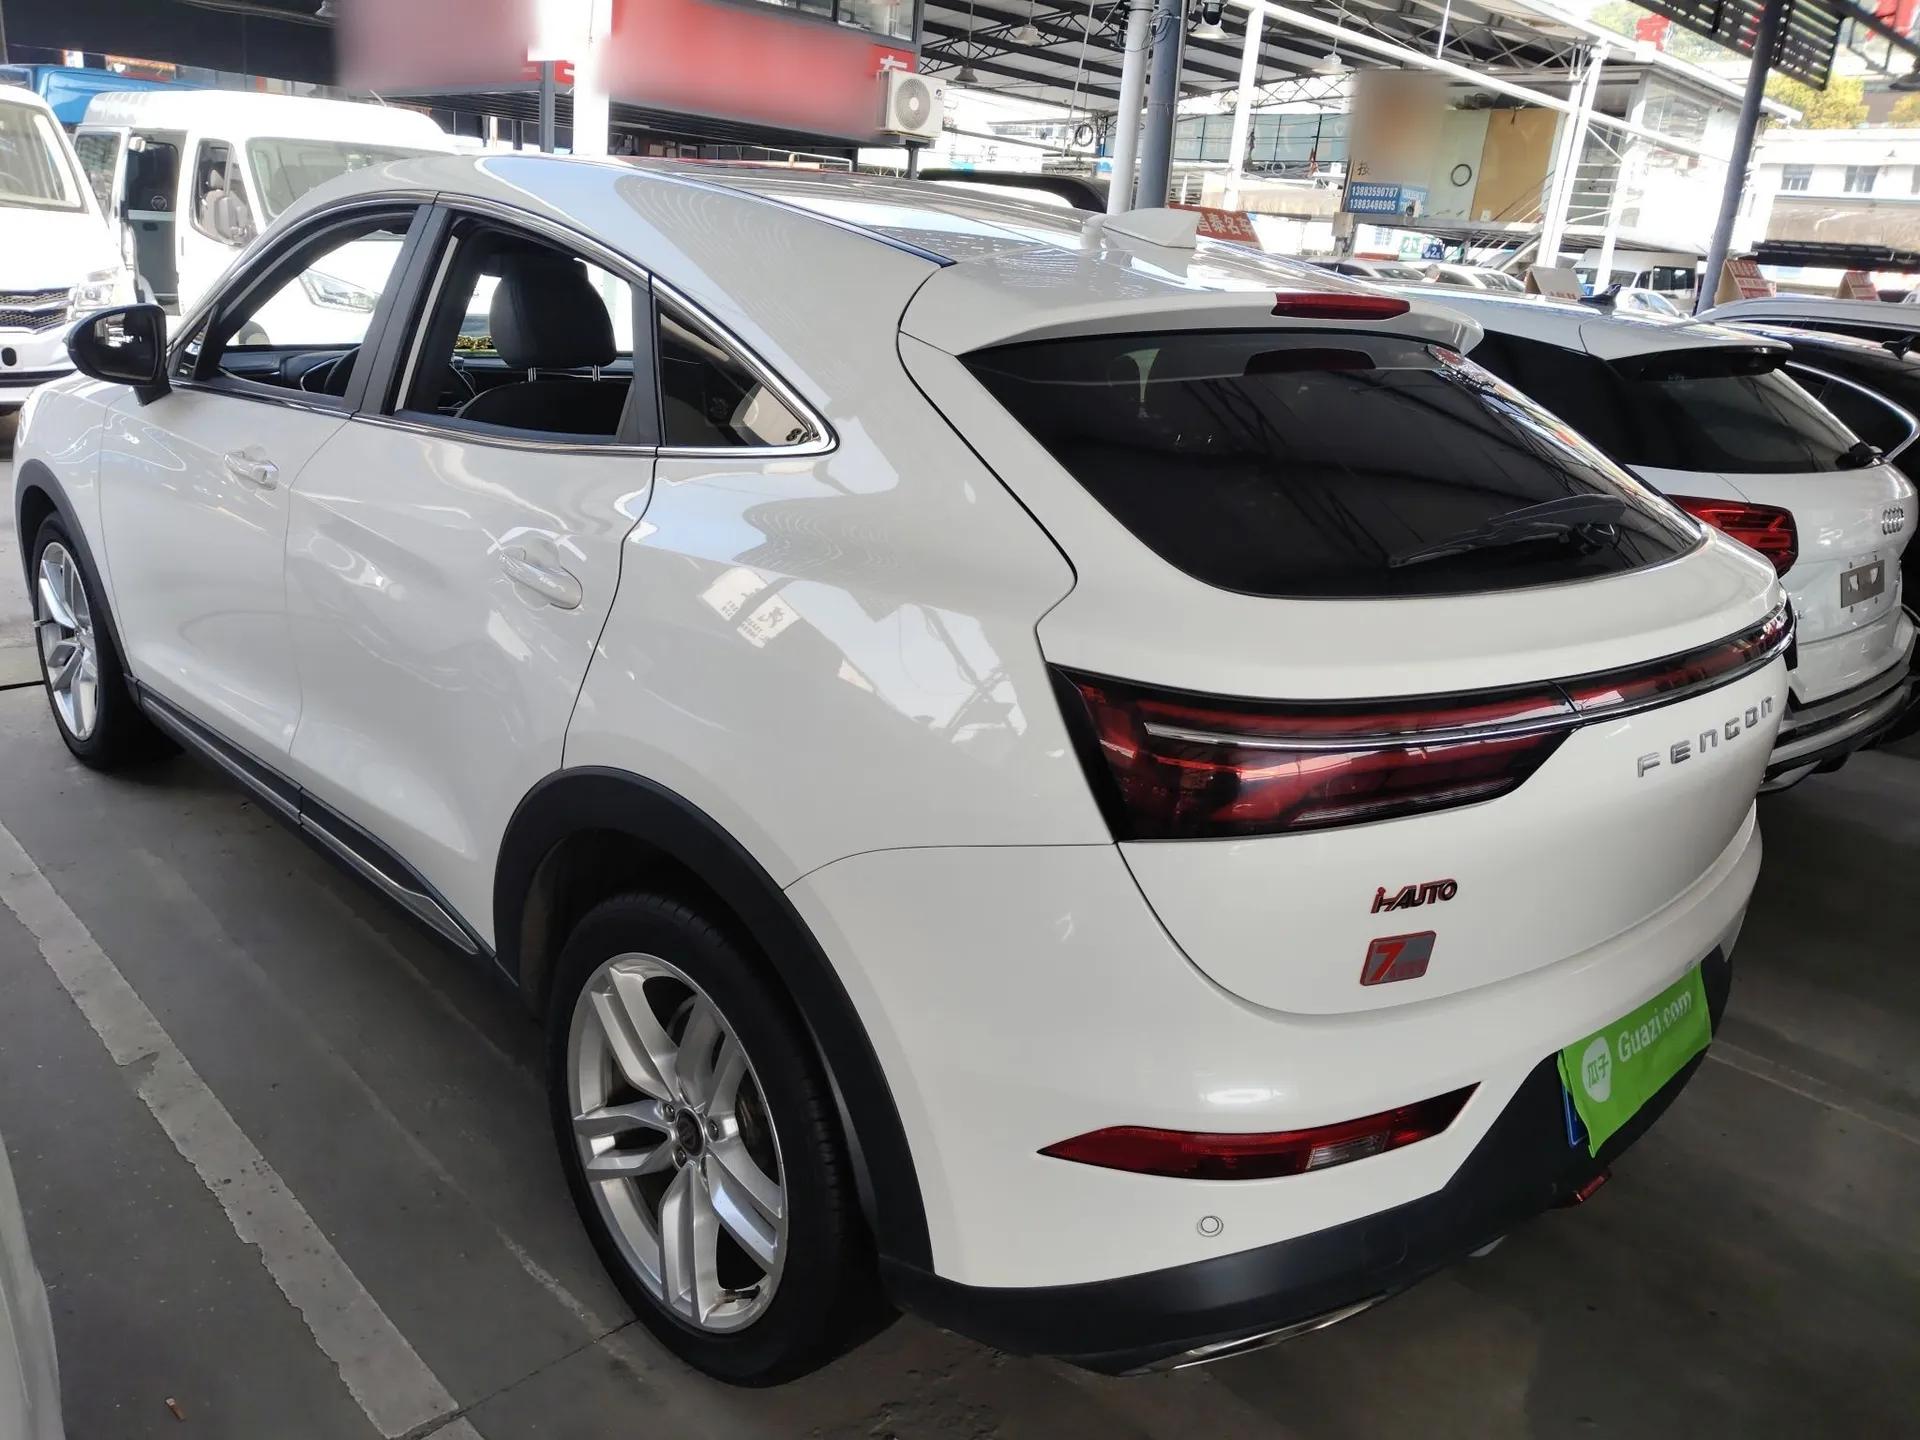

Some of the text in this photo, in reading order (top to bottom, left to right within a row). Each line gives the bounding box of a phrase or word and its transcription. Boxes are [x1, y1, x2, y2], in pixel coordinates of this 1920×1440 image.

[1637, 696, 1774, 777] FENGON
[1617, 990, 1693, 1063] Guazi.com
[1587, 1052, 1610, 1089] 瓜子
